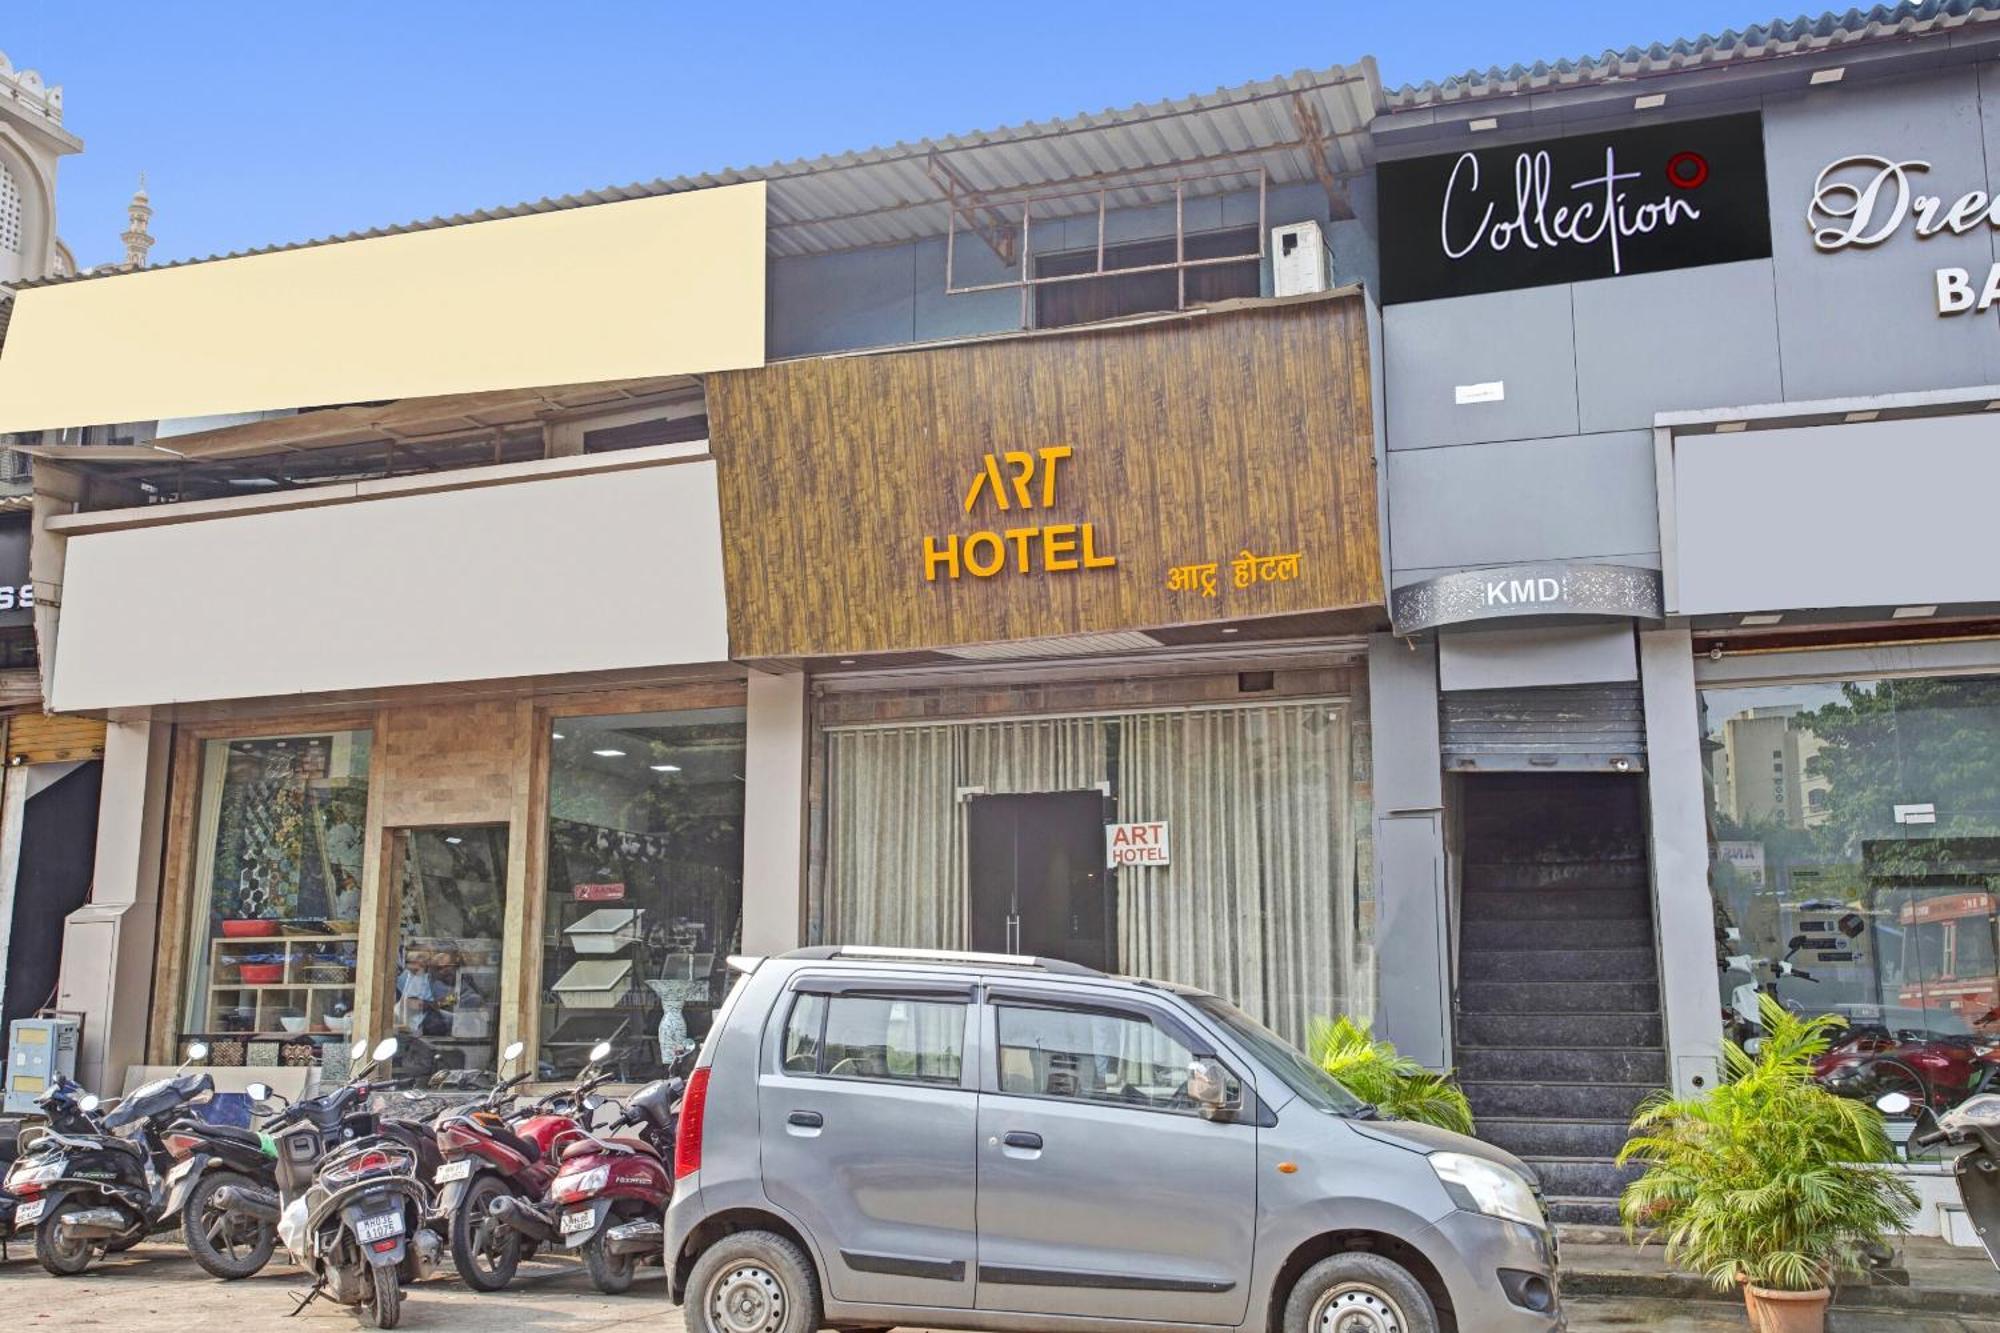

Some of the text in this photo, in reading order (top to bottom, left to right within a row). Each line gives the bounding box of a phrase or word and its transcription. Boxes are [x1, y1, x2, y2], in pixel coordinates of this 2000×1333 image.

[1441, 146, 1701, 275] Collection
[1807, 154, 2000, 250] Dre
[964, 445, 1072, 513] ART
[923, 522, 1116, 581] HOTEL
[1231, 550, 1302, 589] होटल
[1486, 578, 1559, 606] KMD
[1112, 847, 1168, 863] HOTEL
[1113, 824, 1163, 847] ART
